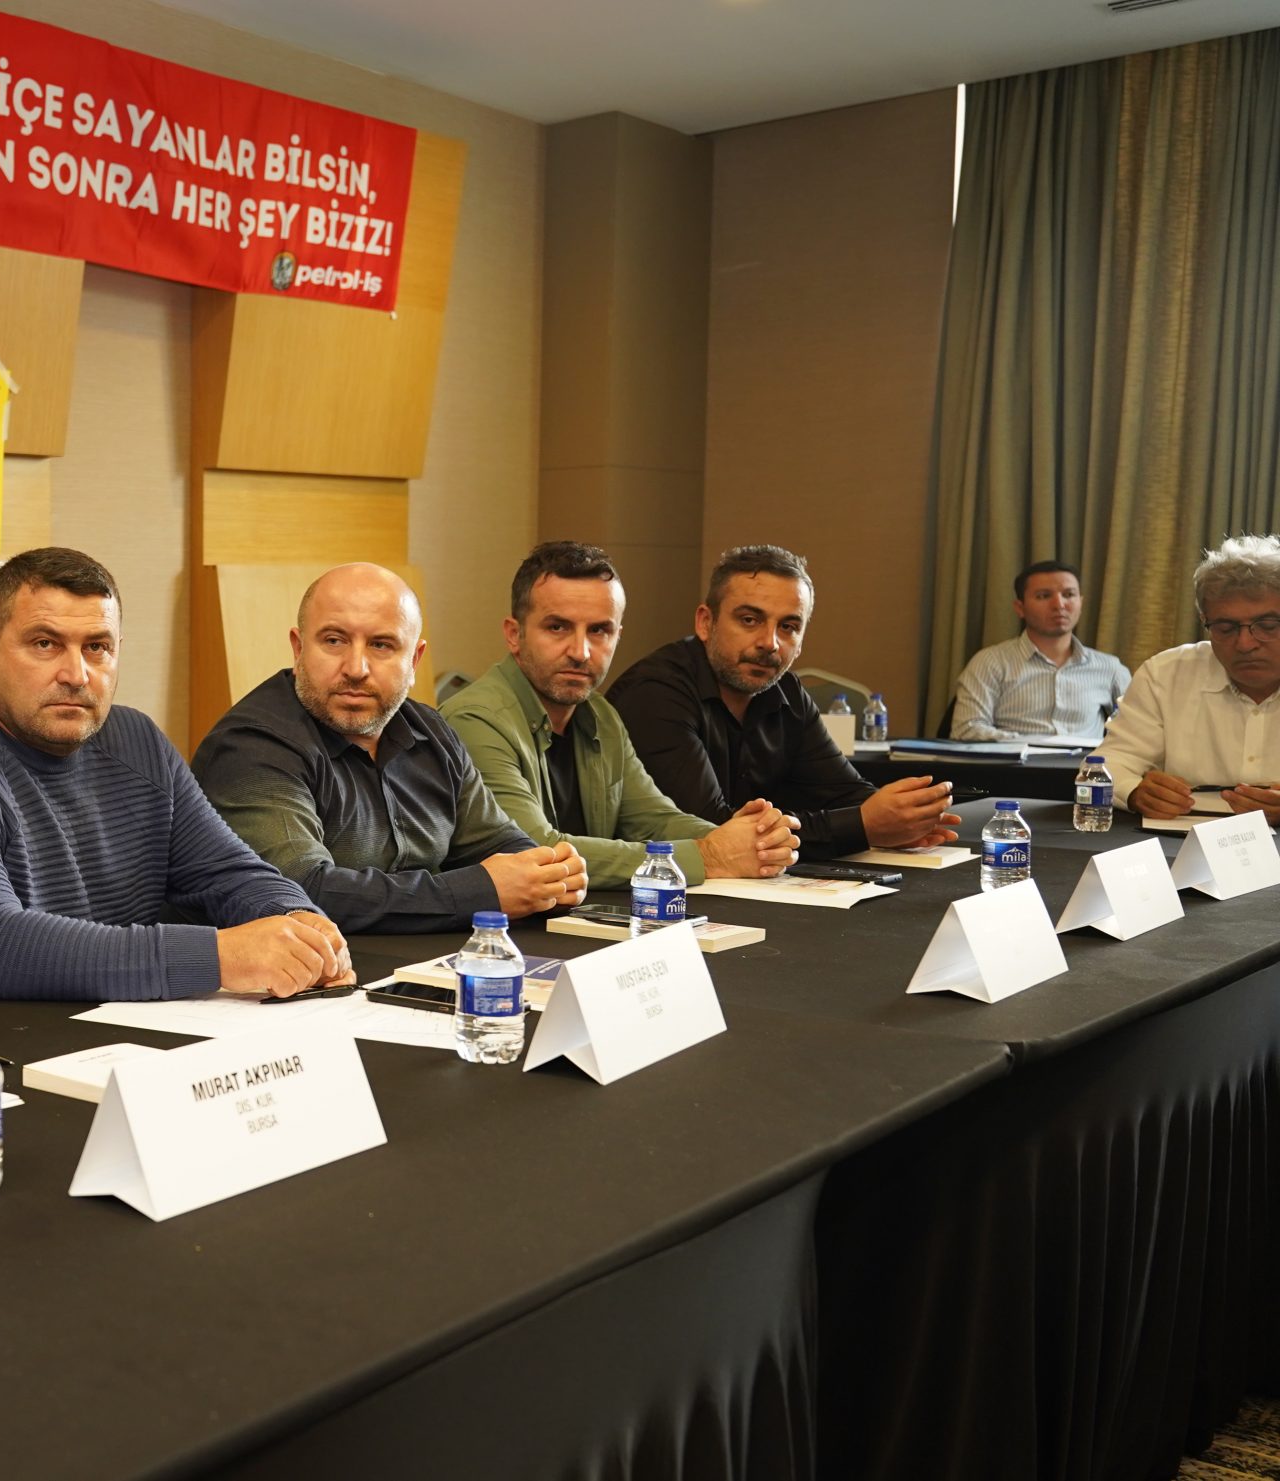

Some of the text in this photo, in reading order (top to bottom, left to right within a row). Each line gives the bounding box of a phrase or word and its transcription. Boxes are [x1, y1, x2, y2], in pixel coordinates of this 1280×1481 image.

[72, 92, 257, 180] SAYANLAR
[263, 133, 377, 205] BİLSİN,
[27, 145, 159, 216] SONRA
[171, 180, 232, 233] HER
[238, 198, 301, 250] ŞEY
[306, 198, 394, 257] BİZİZ!
[1002, 852, 1027, 862] mila
[191, 1055, 304, 1103] MURAT AKPINAR
[247, 1114, 279, 1134] BURSA
